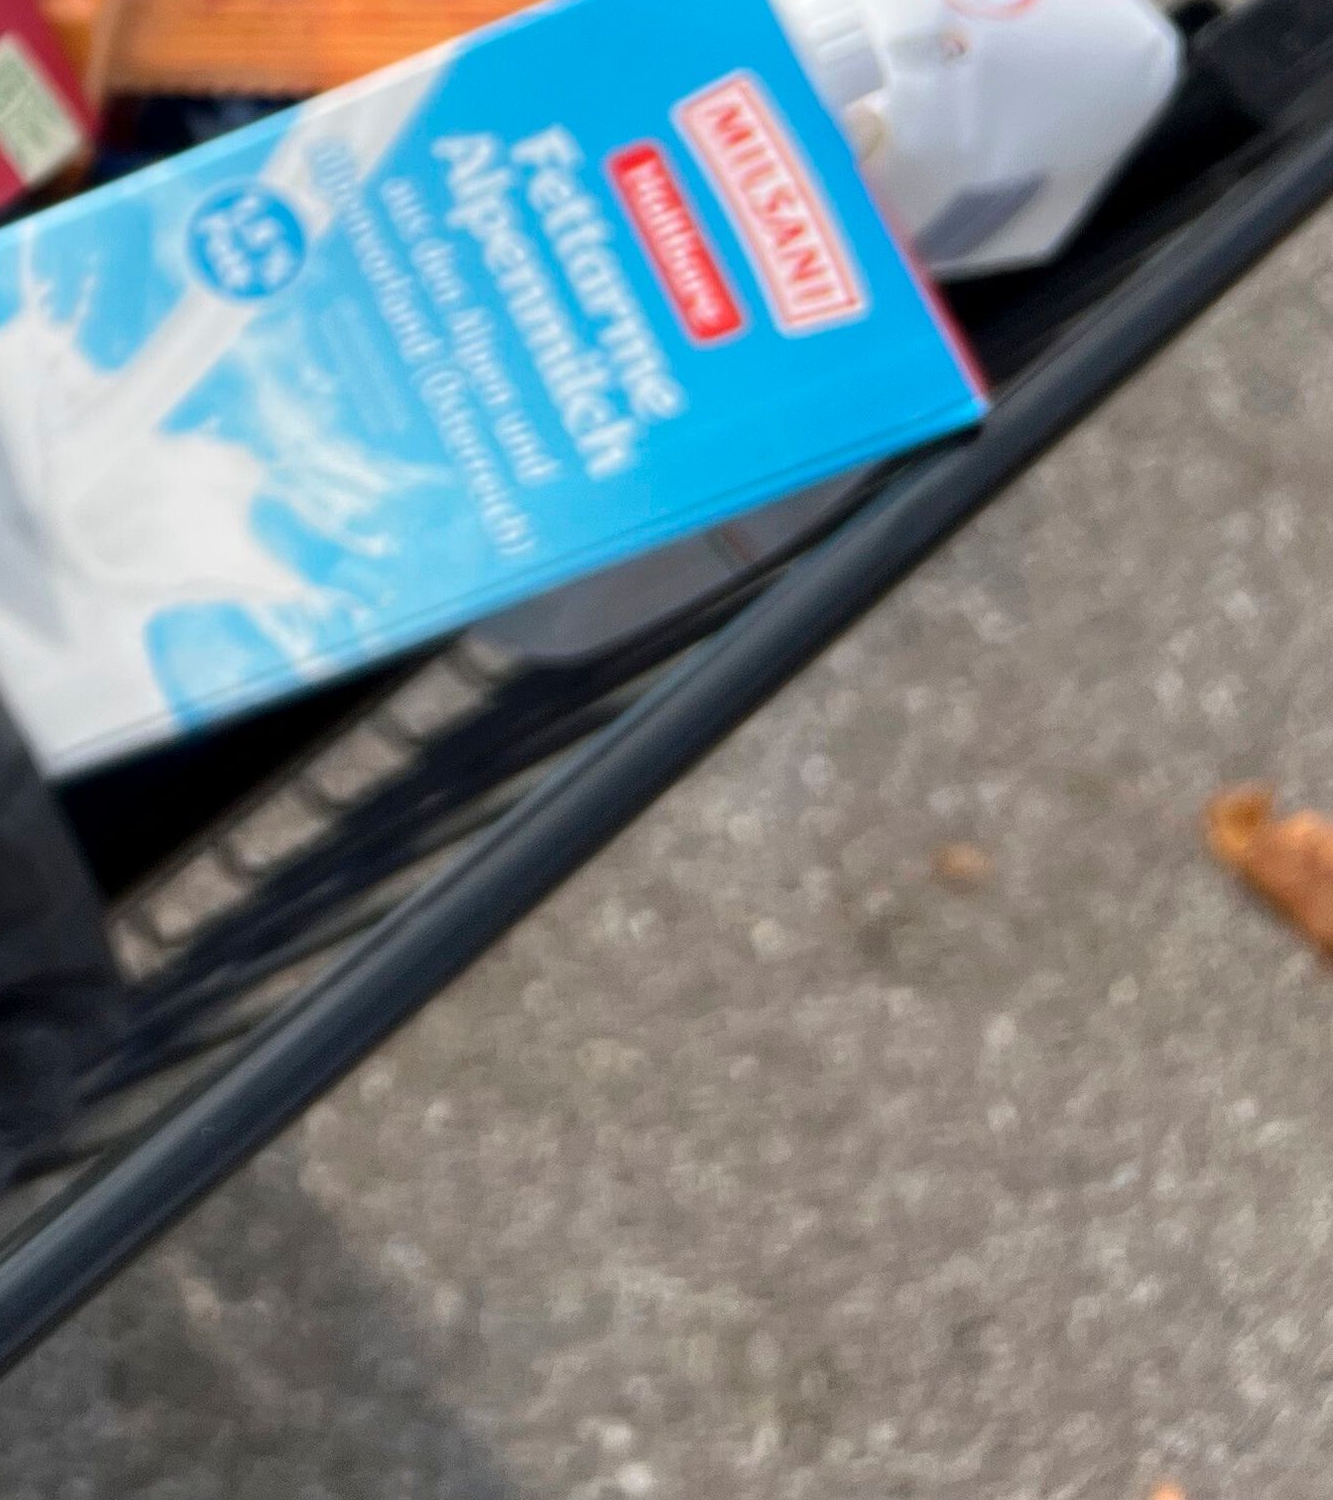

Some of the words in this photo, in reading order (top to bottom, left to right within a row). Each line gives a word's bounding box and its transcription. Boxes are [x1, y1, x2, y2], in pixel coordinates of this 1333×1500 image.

[431, 130, 636, 477] Alpenmilch
[511, 122, 684, 420] Fettarme
[706, 103, 837, 303] MILSANI
